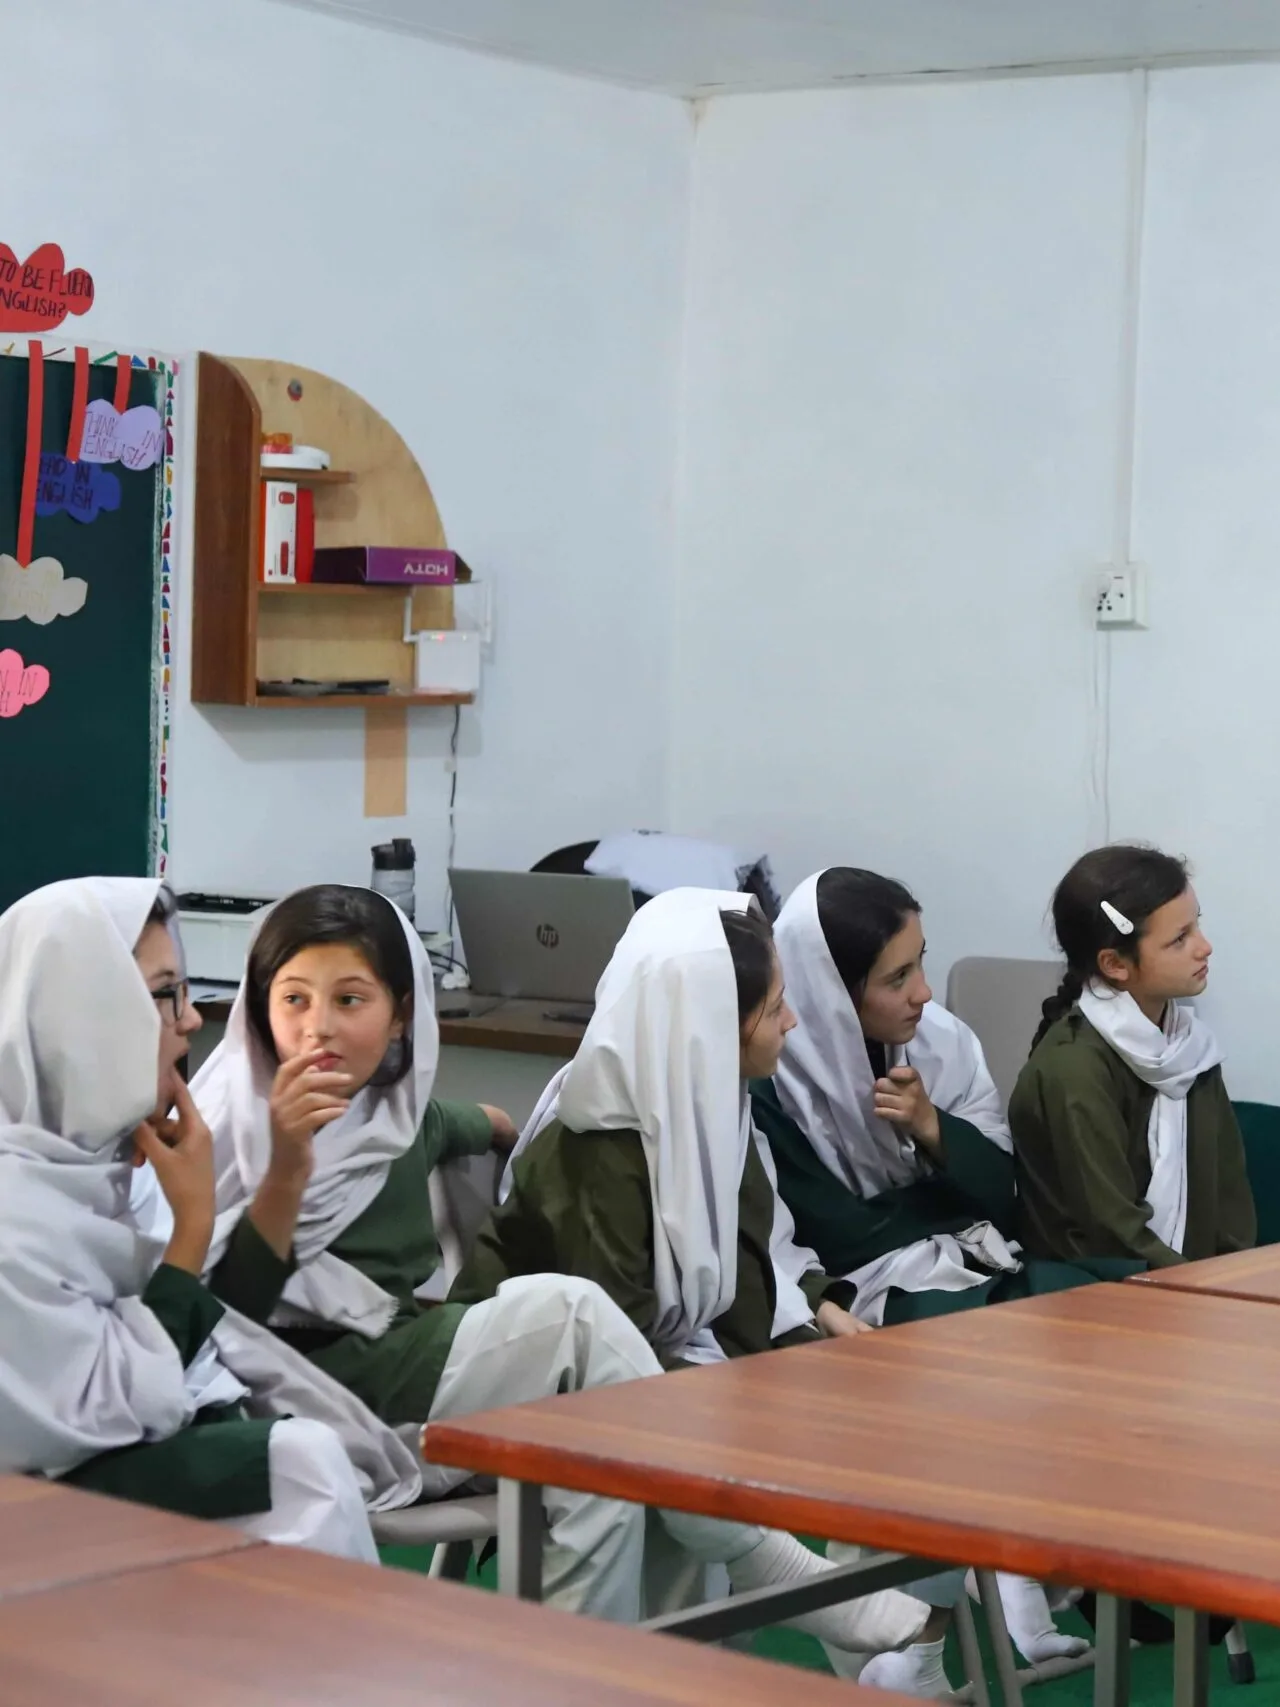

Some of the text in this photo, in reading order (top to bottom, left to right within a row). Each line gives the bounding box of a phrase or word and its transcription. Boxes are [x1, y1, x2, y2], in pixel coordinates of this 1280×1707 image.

[22, 264, 46, 290] BE
[0, 287, 66, 318] NGLISH?
[85, 410, 162, 451] THINK IN
[84, 435, 146, 467] ENGLISH
[36, 478, 93, 510] NGLISH
[403, 562, 449, 576] HDTV
[537, 923, 558, 949] hp
